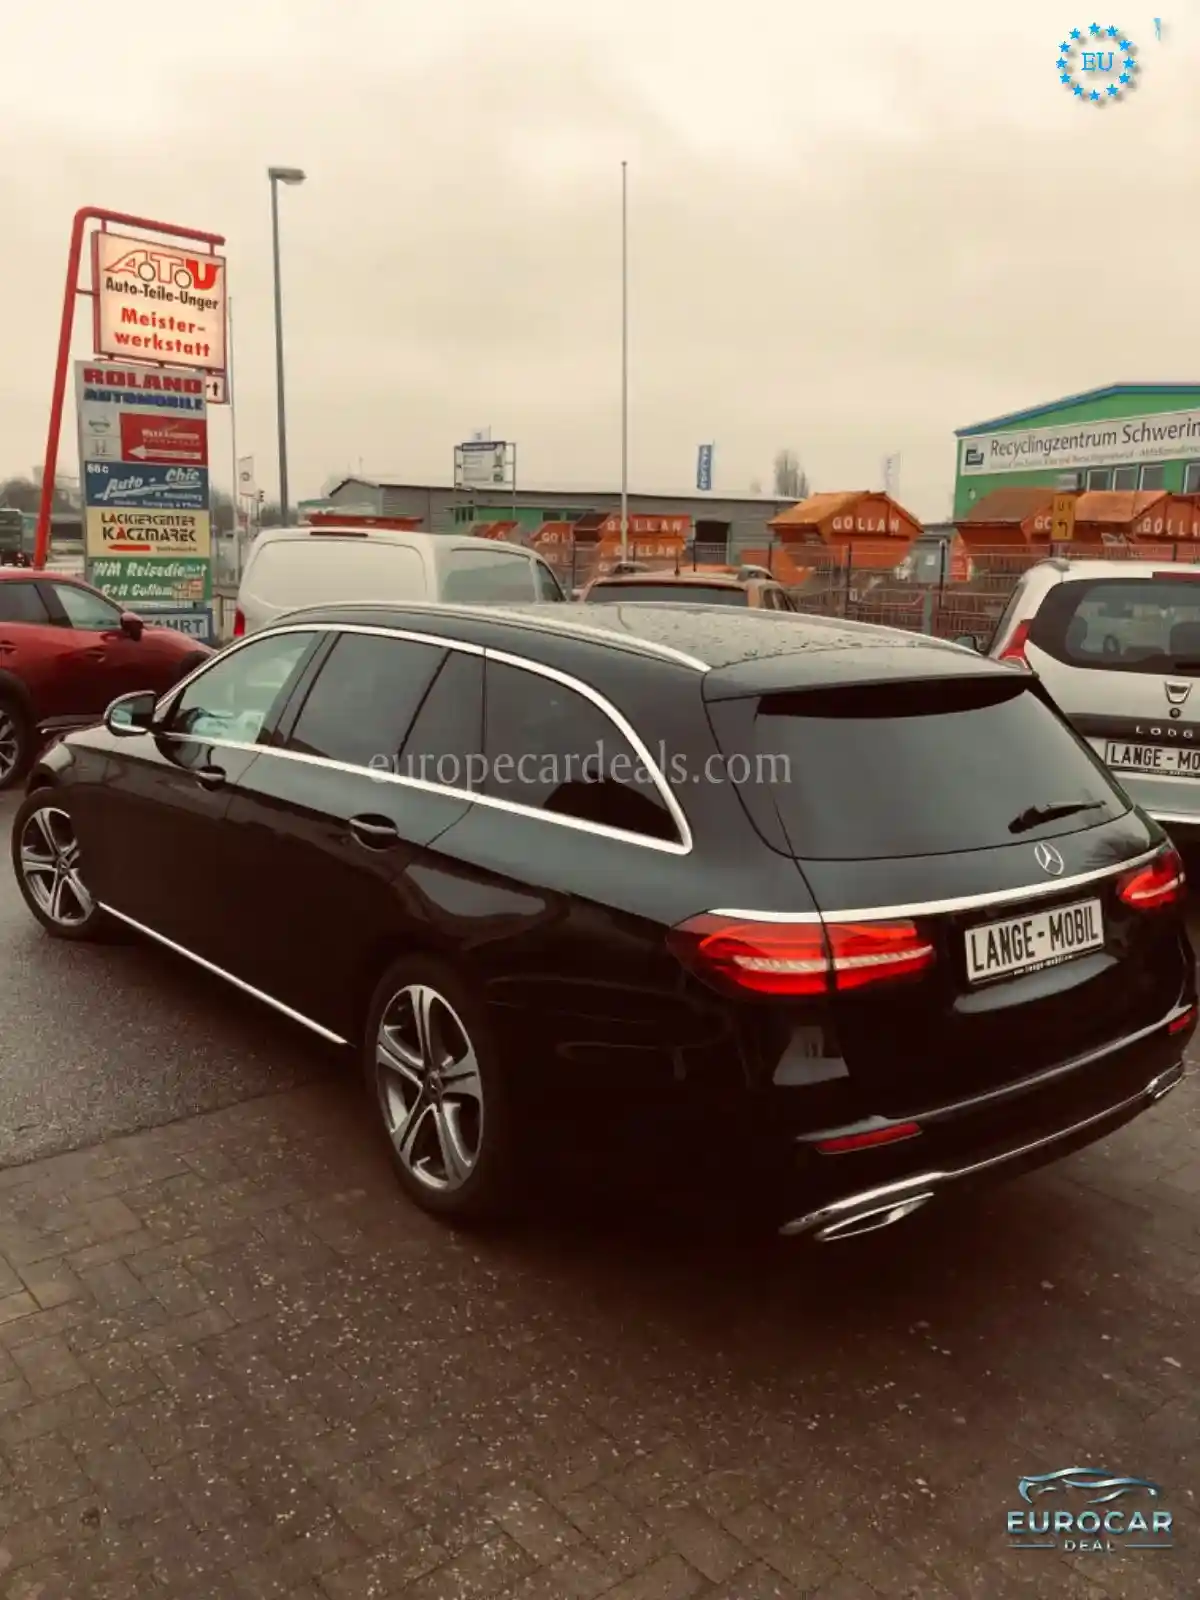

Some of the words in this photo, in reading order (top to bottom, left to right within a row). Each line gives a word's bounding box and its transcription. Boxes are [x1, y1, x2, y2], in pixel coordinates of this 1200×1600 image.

[106, 277, 219, 311] Auto-Teile-Unger
[121, 307, 206, 334] Meister-
[114, 332, 210, 357] werkstatt
[84, 368, 202, 395] ROLAND
[990, 431, 1117, 460] Recyclingzentrum
[1121, 417, 1200, 444] Schwerin
[832, 516, 900, 535] GOLLAN
